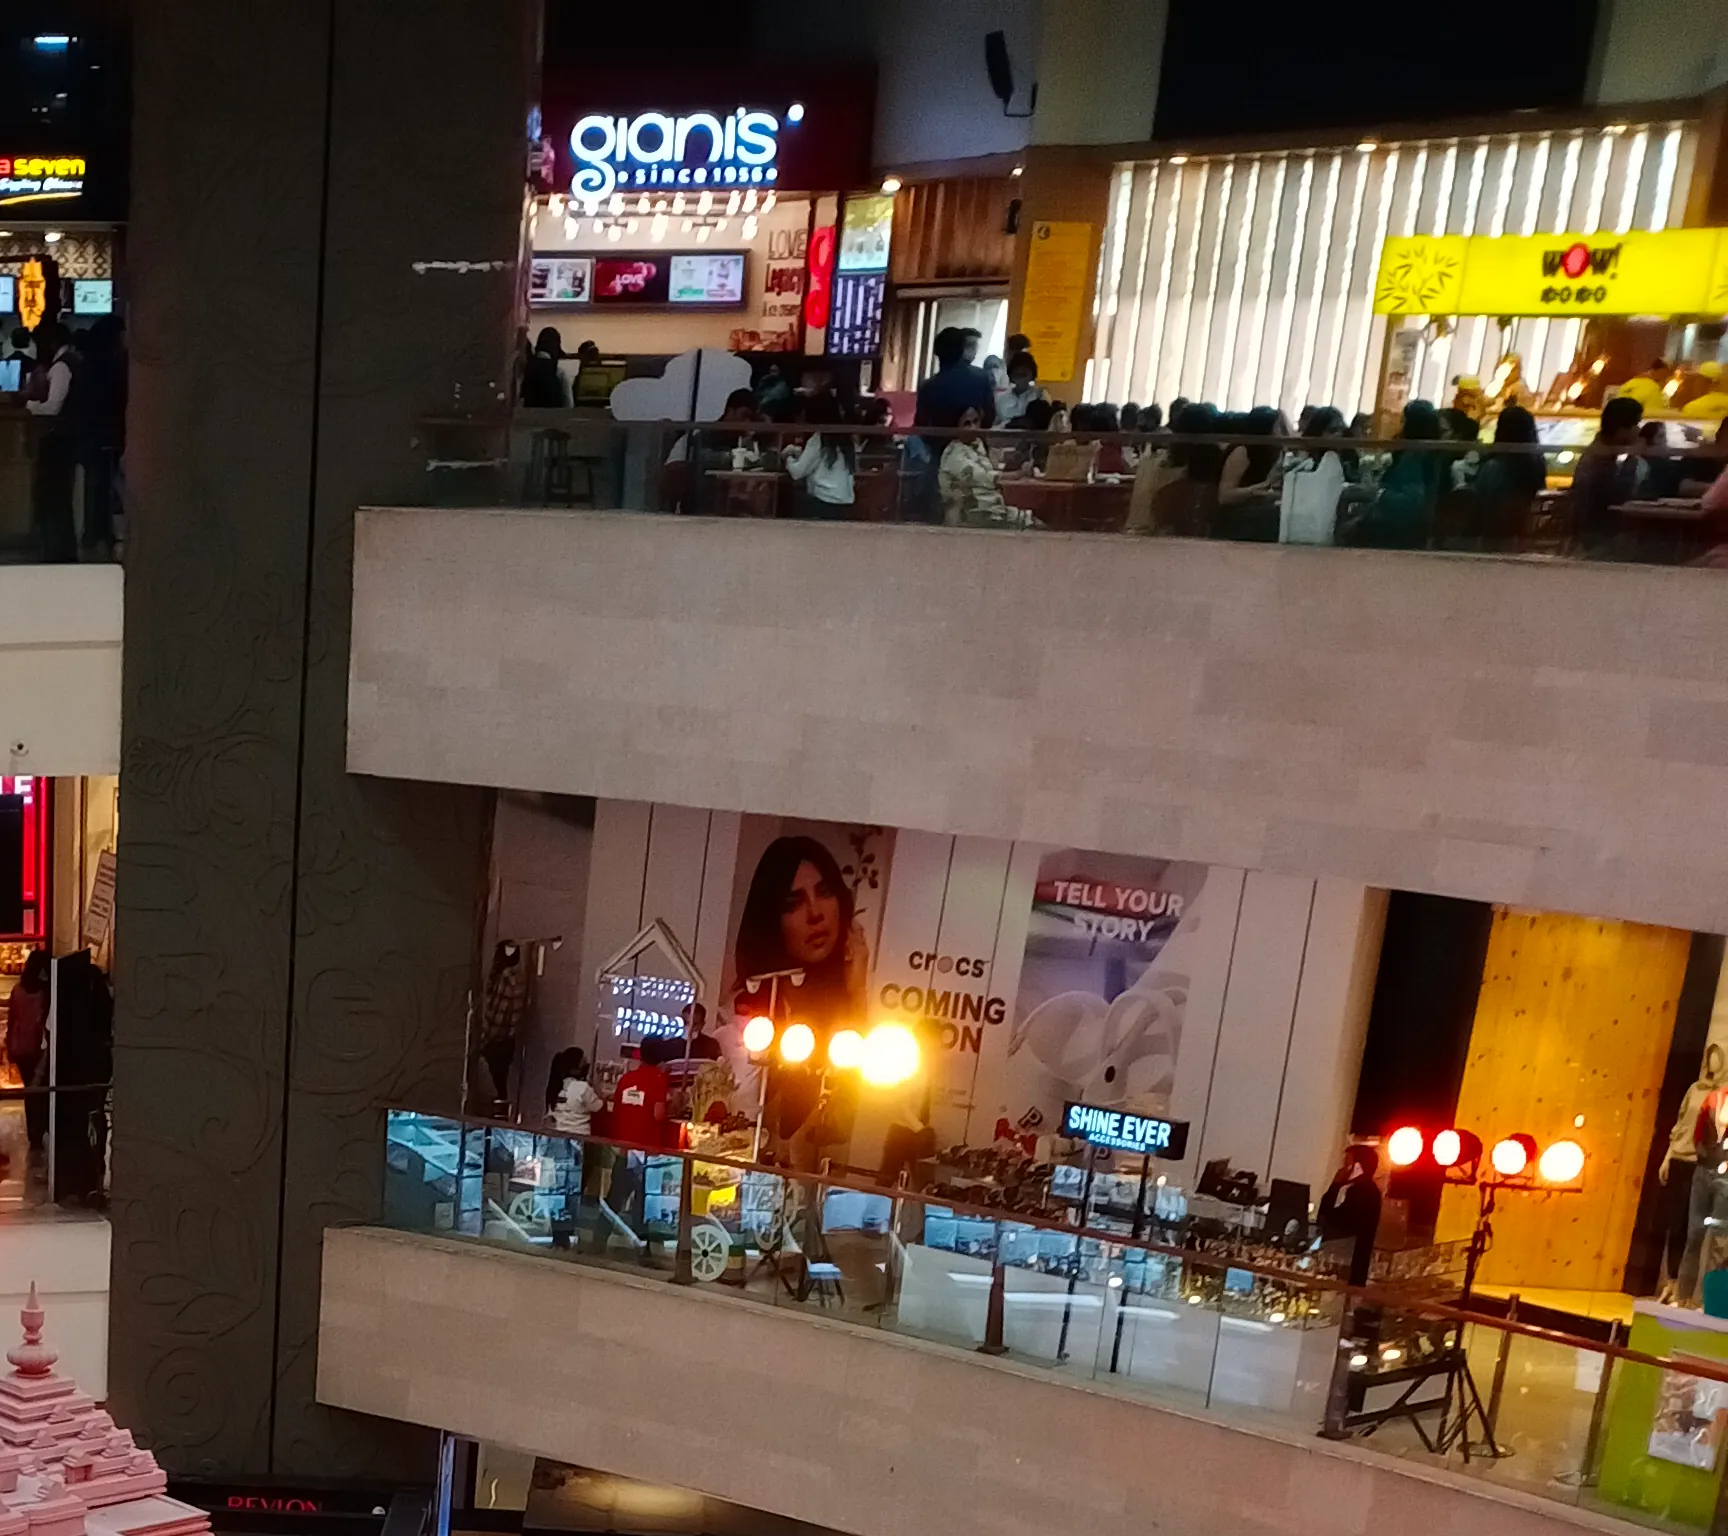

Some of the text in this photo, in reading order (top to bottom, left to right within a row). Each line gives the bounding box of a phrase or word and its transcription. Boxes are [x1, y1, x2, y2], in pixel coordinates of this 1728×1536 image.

[13, 158, 86, 176] seven
[1053, 880, 1185, 917] TELL YOUR
[1073, 914, 1156, 943] STORY
[908, 950, 985, 979] crocs
[879, 982, 1007, 1025] COMING
[1069, 1105, 1172, 1148] SHINE EVER
